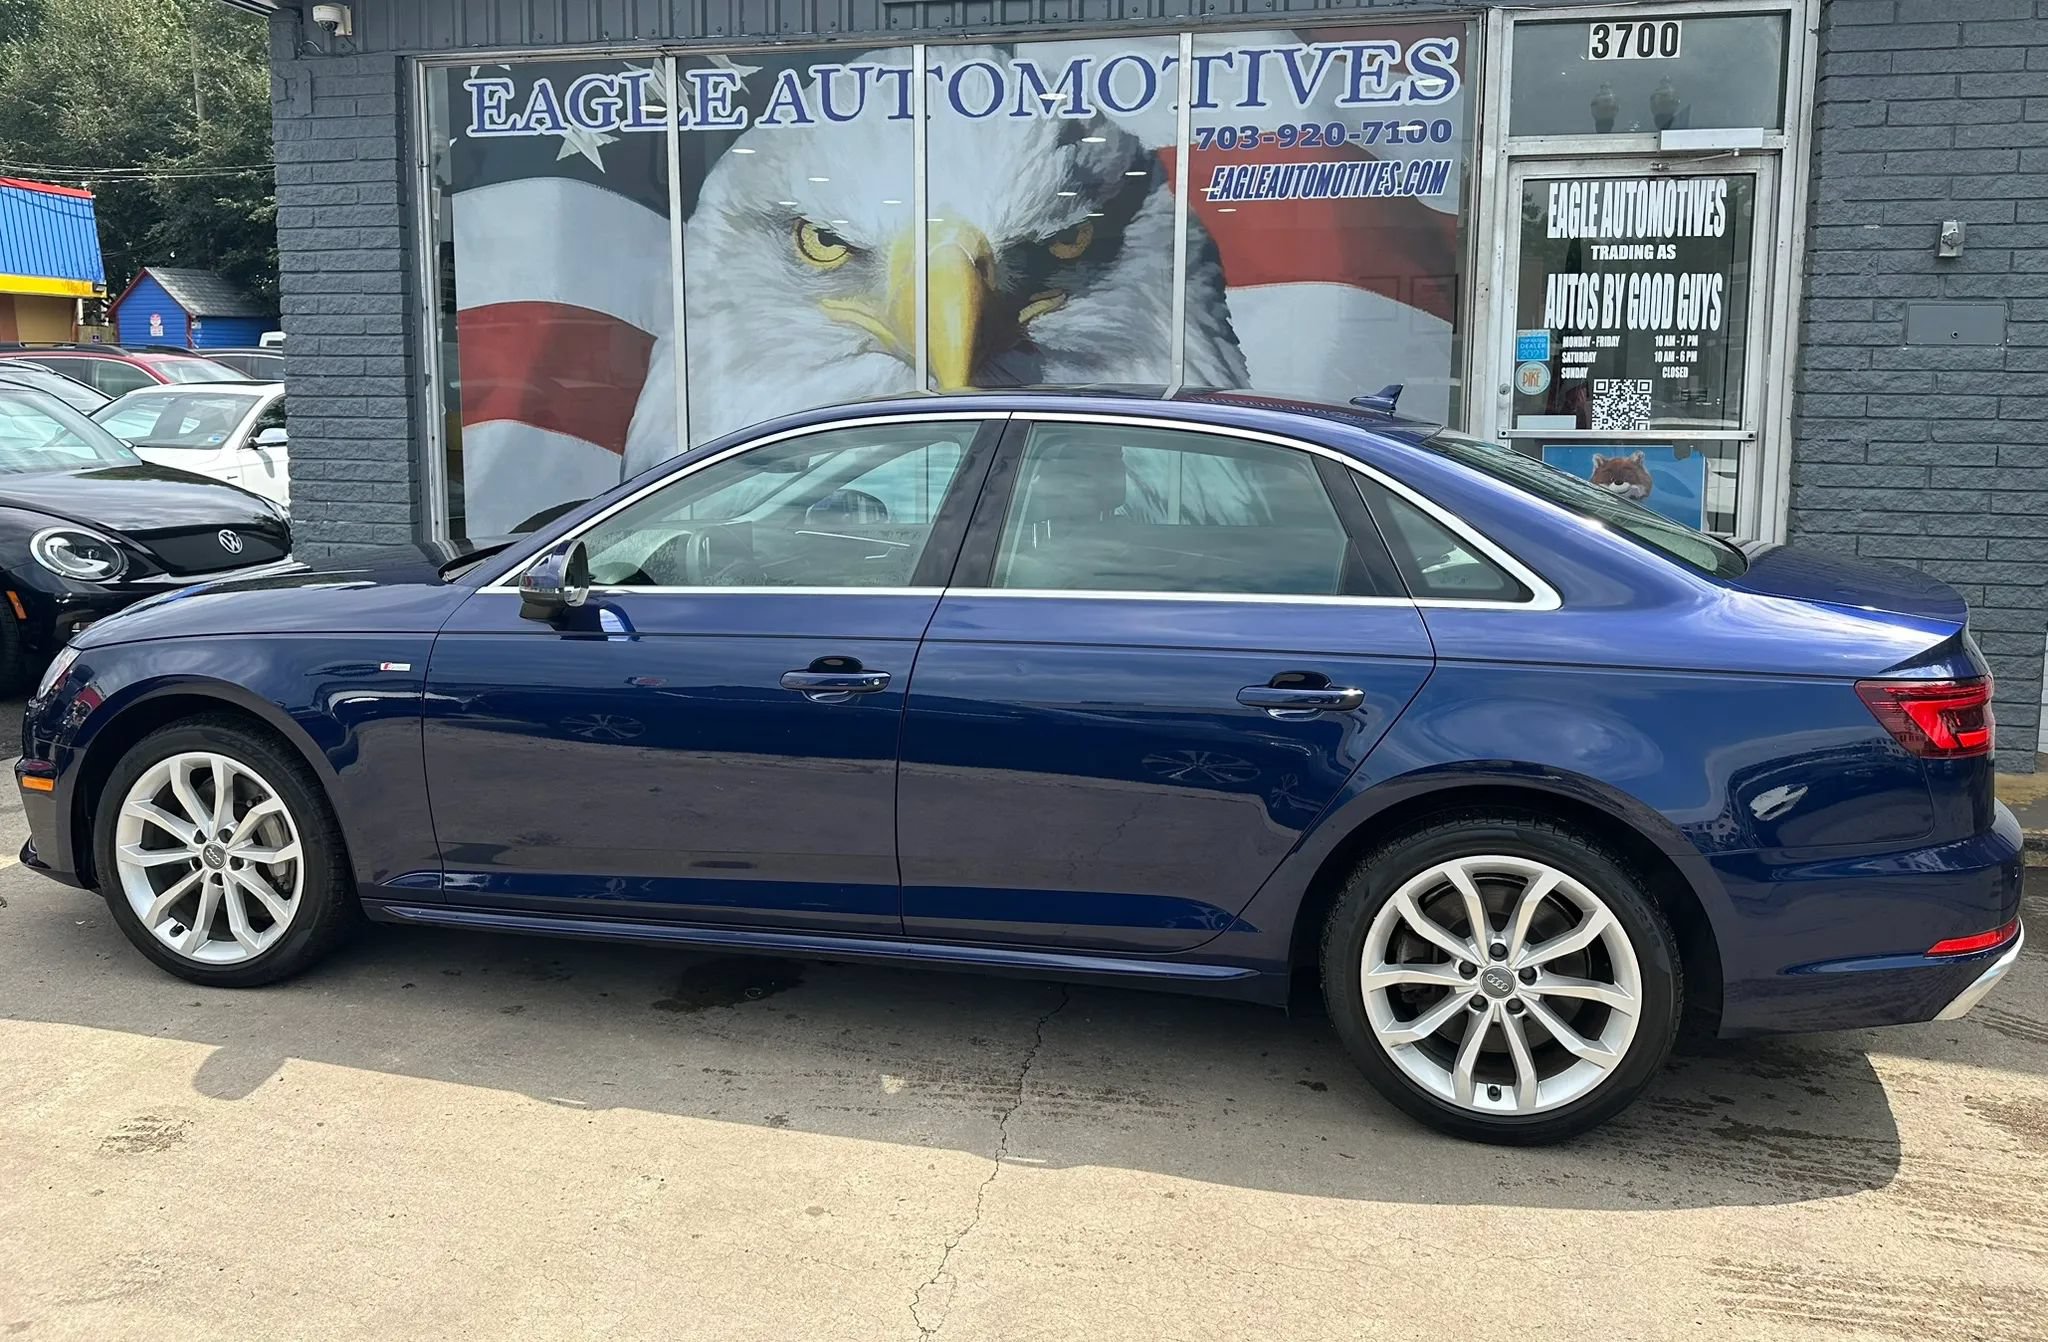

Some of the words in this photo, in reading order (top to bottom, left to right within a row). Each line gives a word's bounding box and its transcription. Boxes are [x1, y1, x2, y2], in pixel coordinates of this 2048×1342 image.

[1590, 22, 1679, 59] 3700
[466, 70, 746, 136] EAGLE
[757, 40, 1459, 126] AUTOMOTIVES
[1196, 119, 1452, 150] 703-920-7100
[1207, 160, 1453, 201] EAGLEAUTOMOTIVES.COM
[1547, 181, 1600, 239] EAGLE
[1600, 179, 1727, 239] AUTOMOTIVES
[1591, 245, 1654, 260] TRADING
[1656, 244, 1677, 260] AS
[1544, 273, 1600, 330] AUTOS
[1601, 273, 1626, 329] BY
[1627, 273, 1675, 330] GOOD
[1677, 273, 1723, 331] GUYS
[1561, 351, 1597, 363] SATURDAY
[1654, 350, 1663, 363] 10
[1663, 350, 1675, 363] AM
[1680, 350, 1685, 363] 6
[1686, 350, 1698, 363] PM
[1562, 335, 1591, 348] MONDAY
[1596, 335, 1620, 348] FRIDAY
[1654, 334, 1664, 347] 10
[1664, 334, 1676, 347] AM
[1680, 334, 1685, 347] 7
[1687, 334, 1699, 347] PM
[1561, 367, 1588, 379] SUNDAY
[1662, 366, 1689, 379] CLOSED
